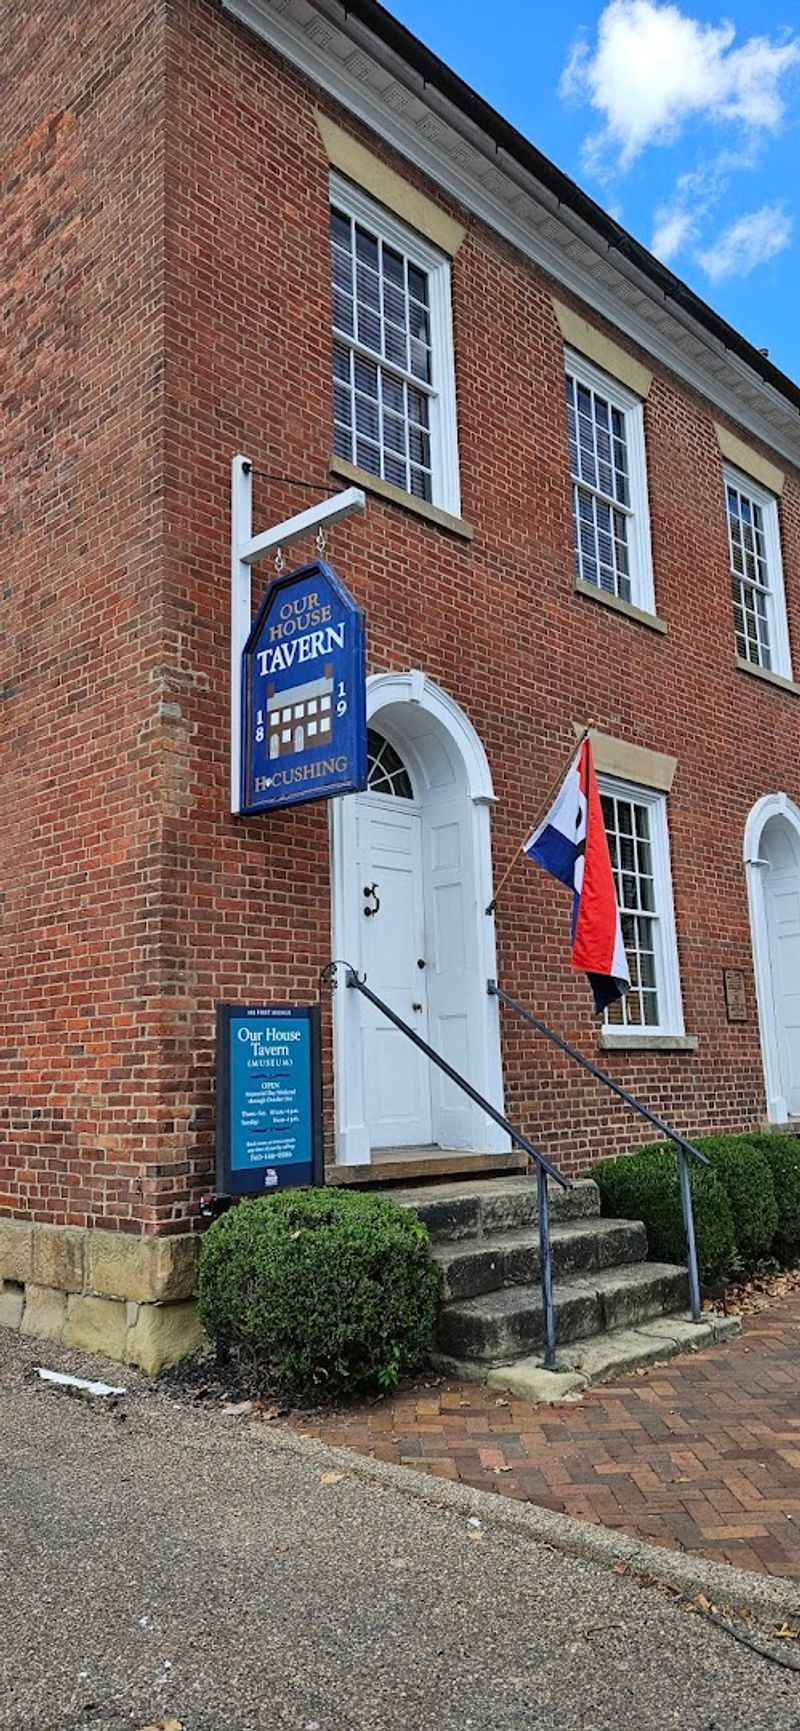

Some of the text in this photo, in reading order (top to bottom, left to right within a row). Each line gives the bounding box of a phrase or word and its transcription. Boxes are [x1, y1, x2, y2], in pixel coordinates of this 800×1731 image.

[280, 592, 320, 620] OUR
[269, 605, 332, 642] HOUSE
[257, 622, 345, 676] TAVERN
[237, 1027, 301, 1042] Our House
[250, 1042, 289, 1056] Tavern
[261, 1081, 280, 1090] OPEN
